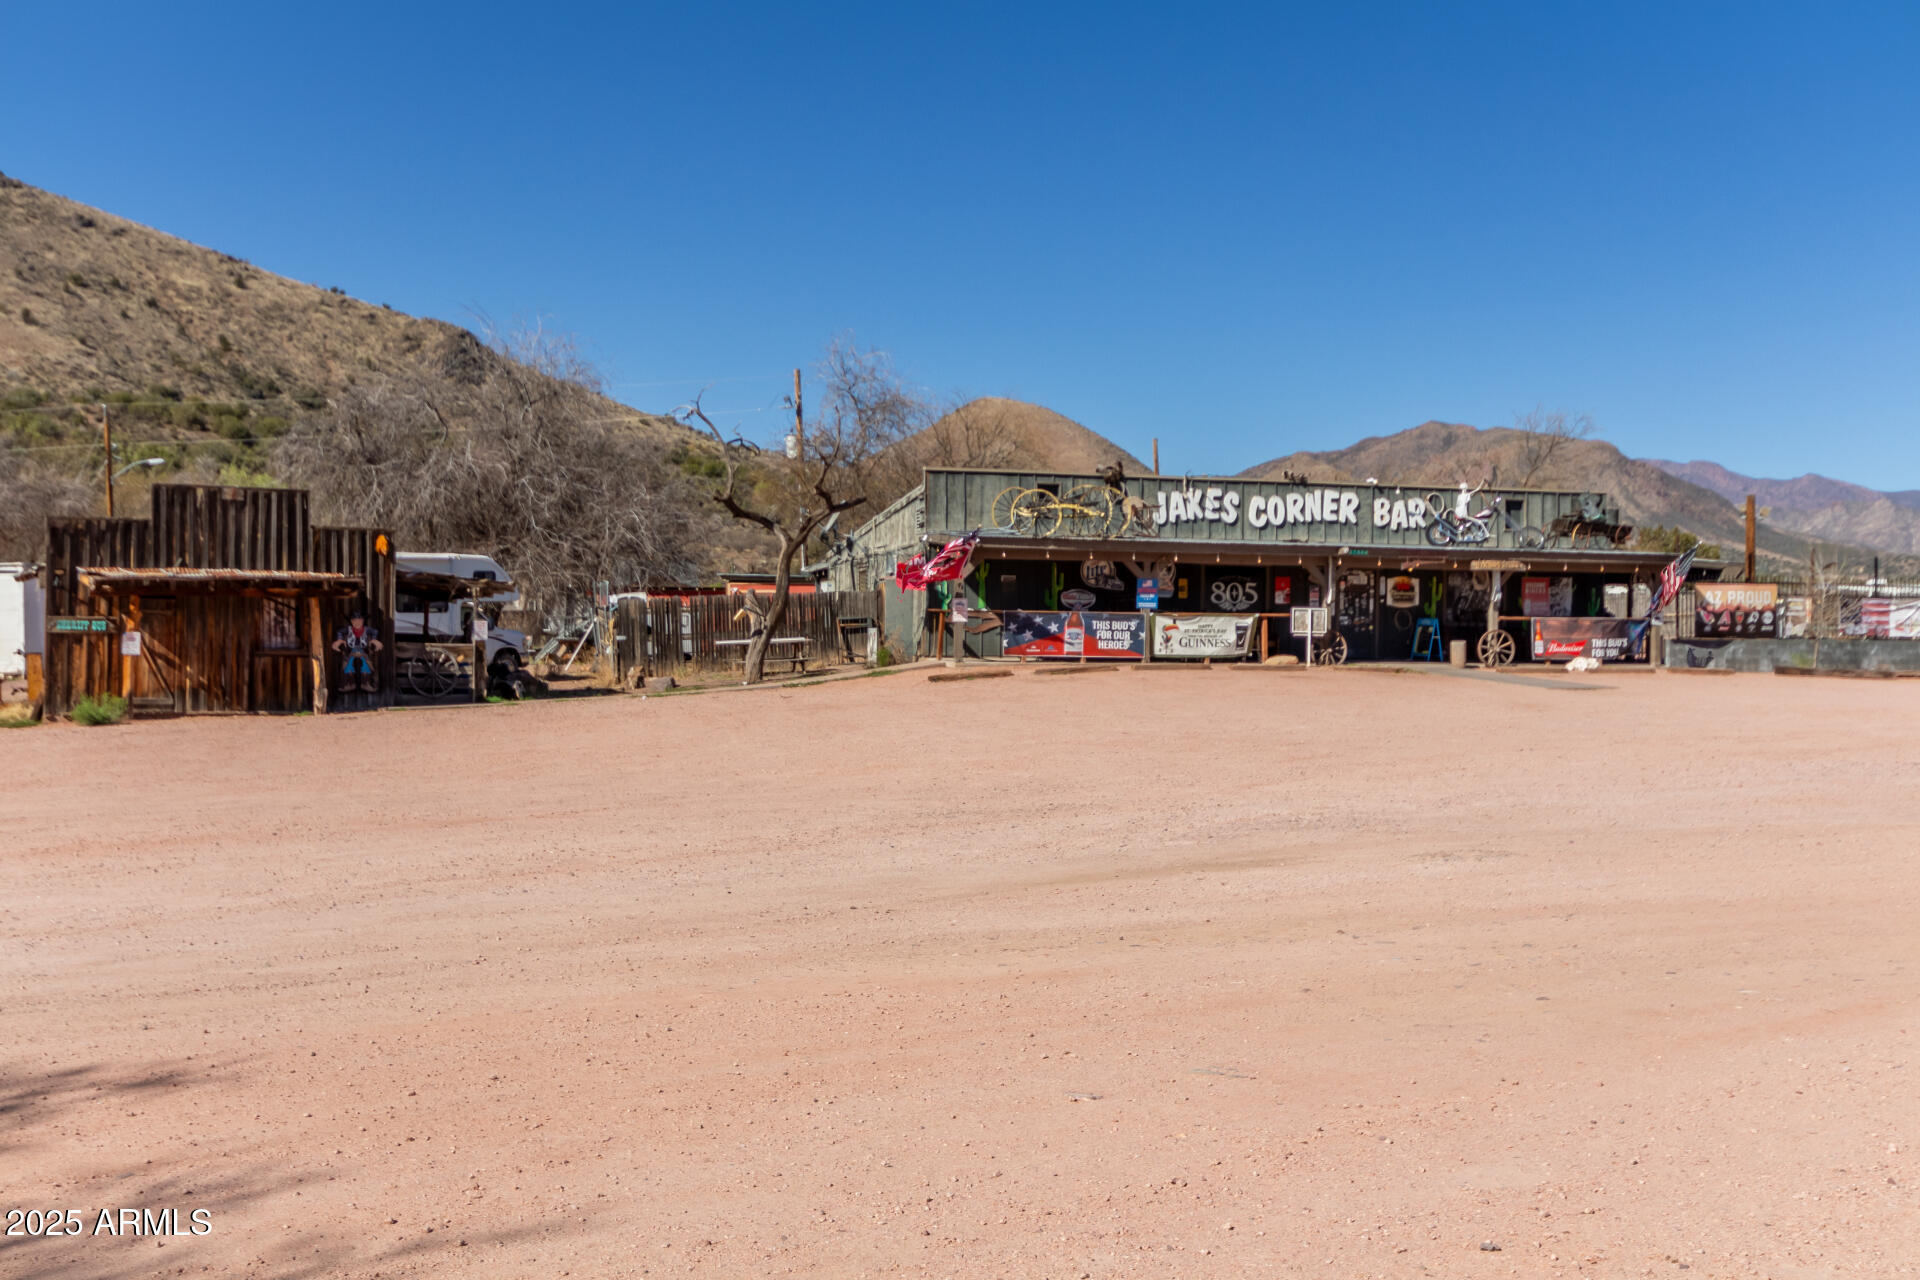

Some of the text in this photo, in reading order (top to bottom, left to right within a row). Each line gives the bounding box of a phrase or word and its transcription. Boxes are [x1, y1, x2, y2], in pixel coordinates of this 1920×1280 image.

[1152, 487, 1427, 532] JAKES CORNER BAR
[1210, 581, 1259, 605] 805
[1705, 590, 1772, 605] AZ PROUD
[1092, 620, 1137, 631] THIS BUD'S
[1096, 630, 1131, 641] FOR OUR
[1179, 636, 1232, 648] GUINNESS
[1592, 638, 1607, 648] THIS
